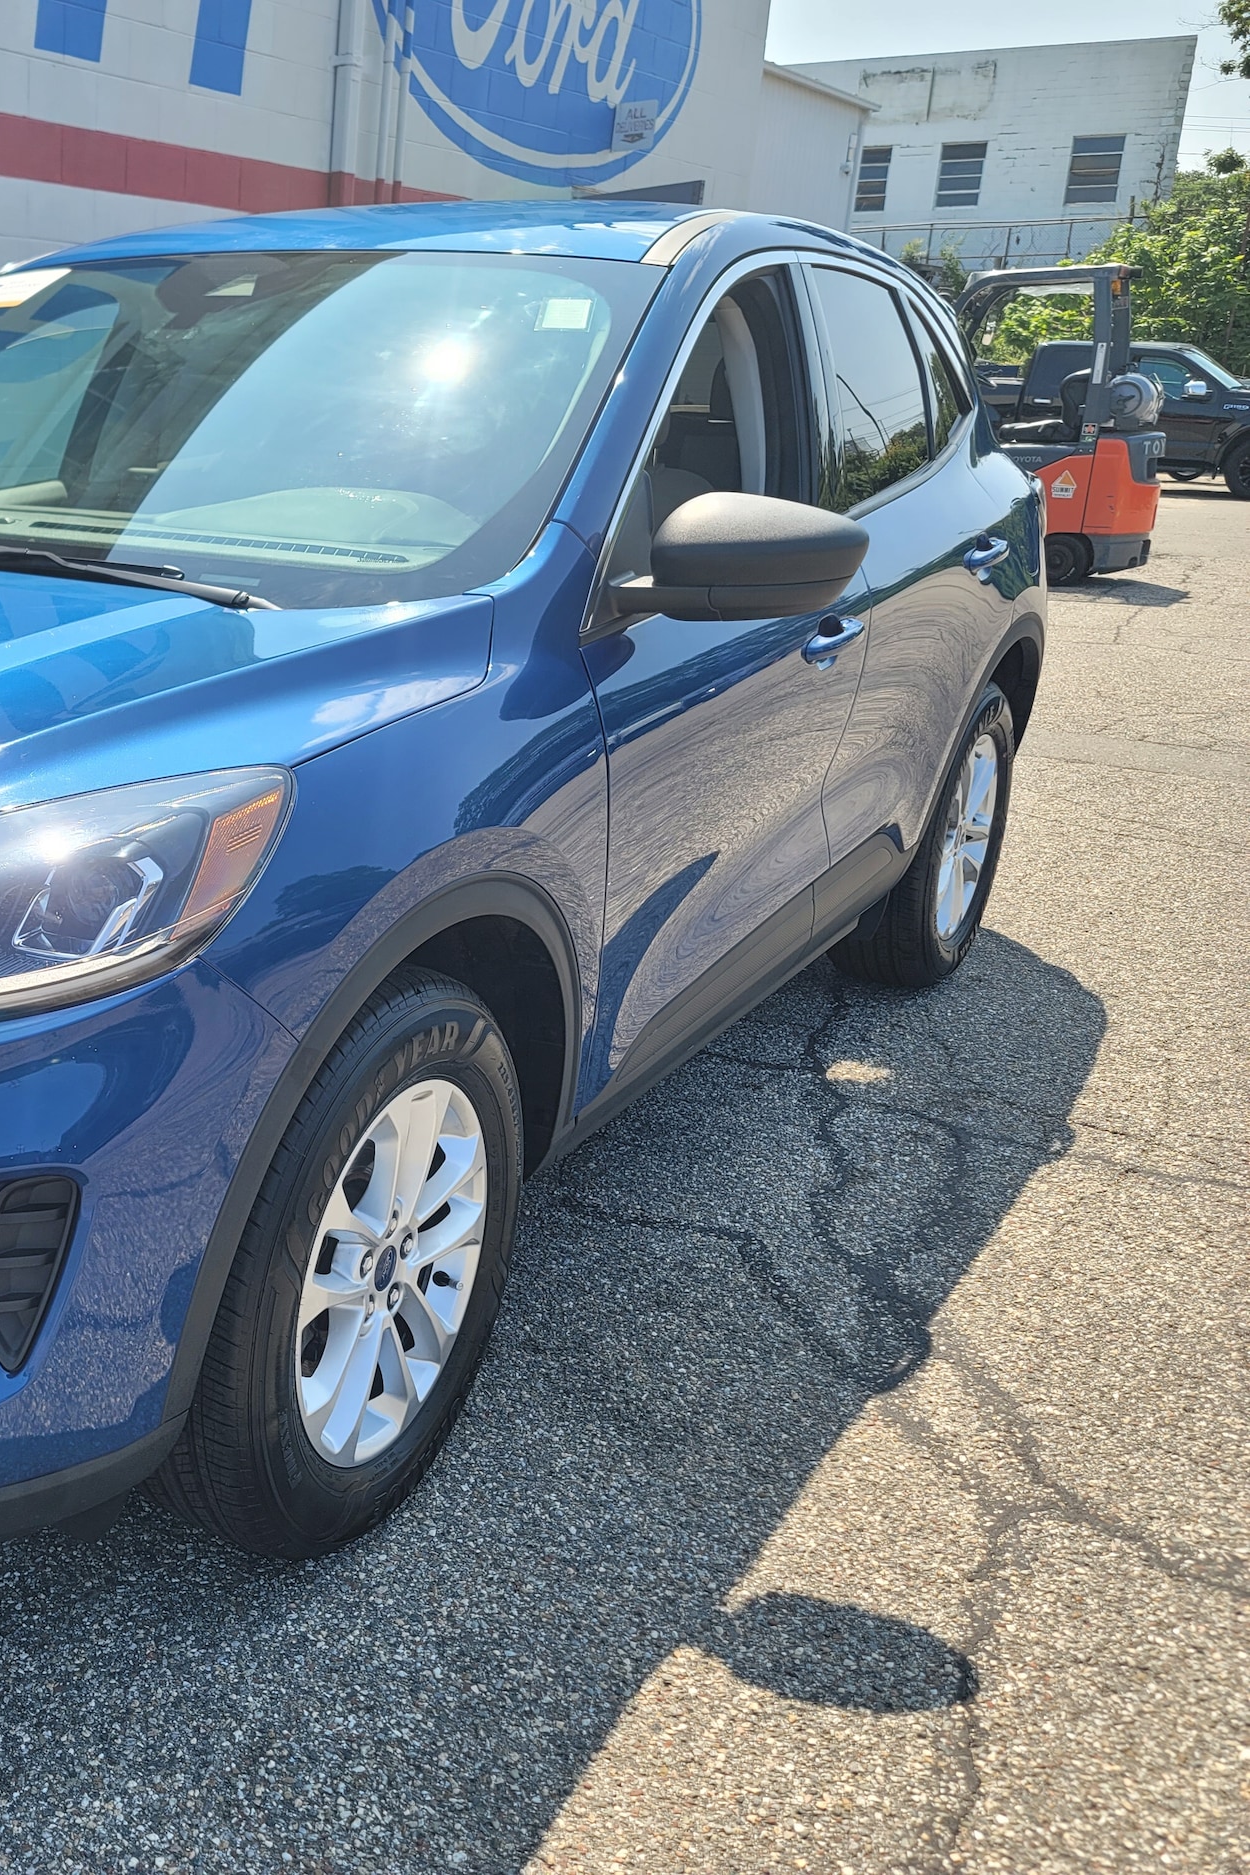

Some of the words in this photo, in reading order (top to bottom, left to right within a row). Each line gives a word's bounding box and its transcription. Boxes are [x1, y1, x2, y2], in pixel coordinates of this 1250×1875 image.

[625, 107, 647, 120] ALL
[615, 118, 655, 133] DELIVERIES
[1012, 455, 1042, 463] OYOTA
[308, 1021, 460, 1226] GOODYEAR
